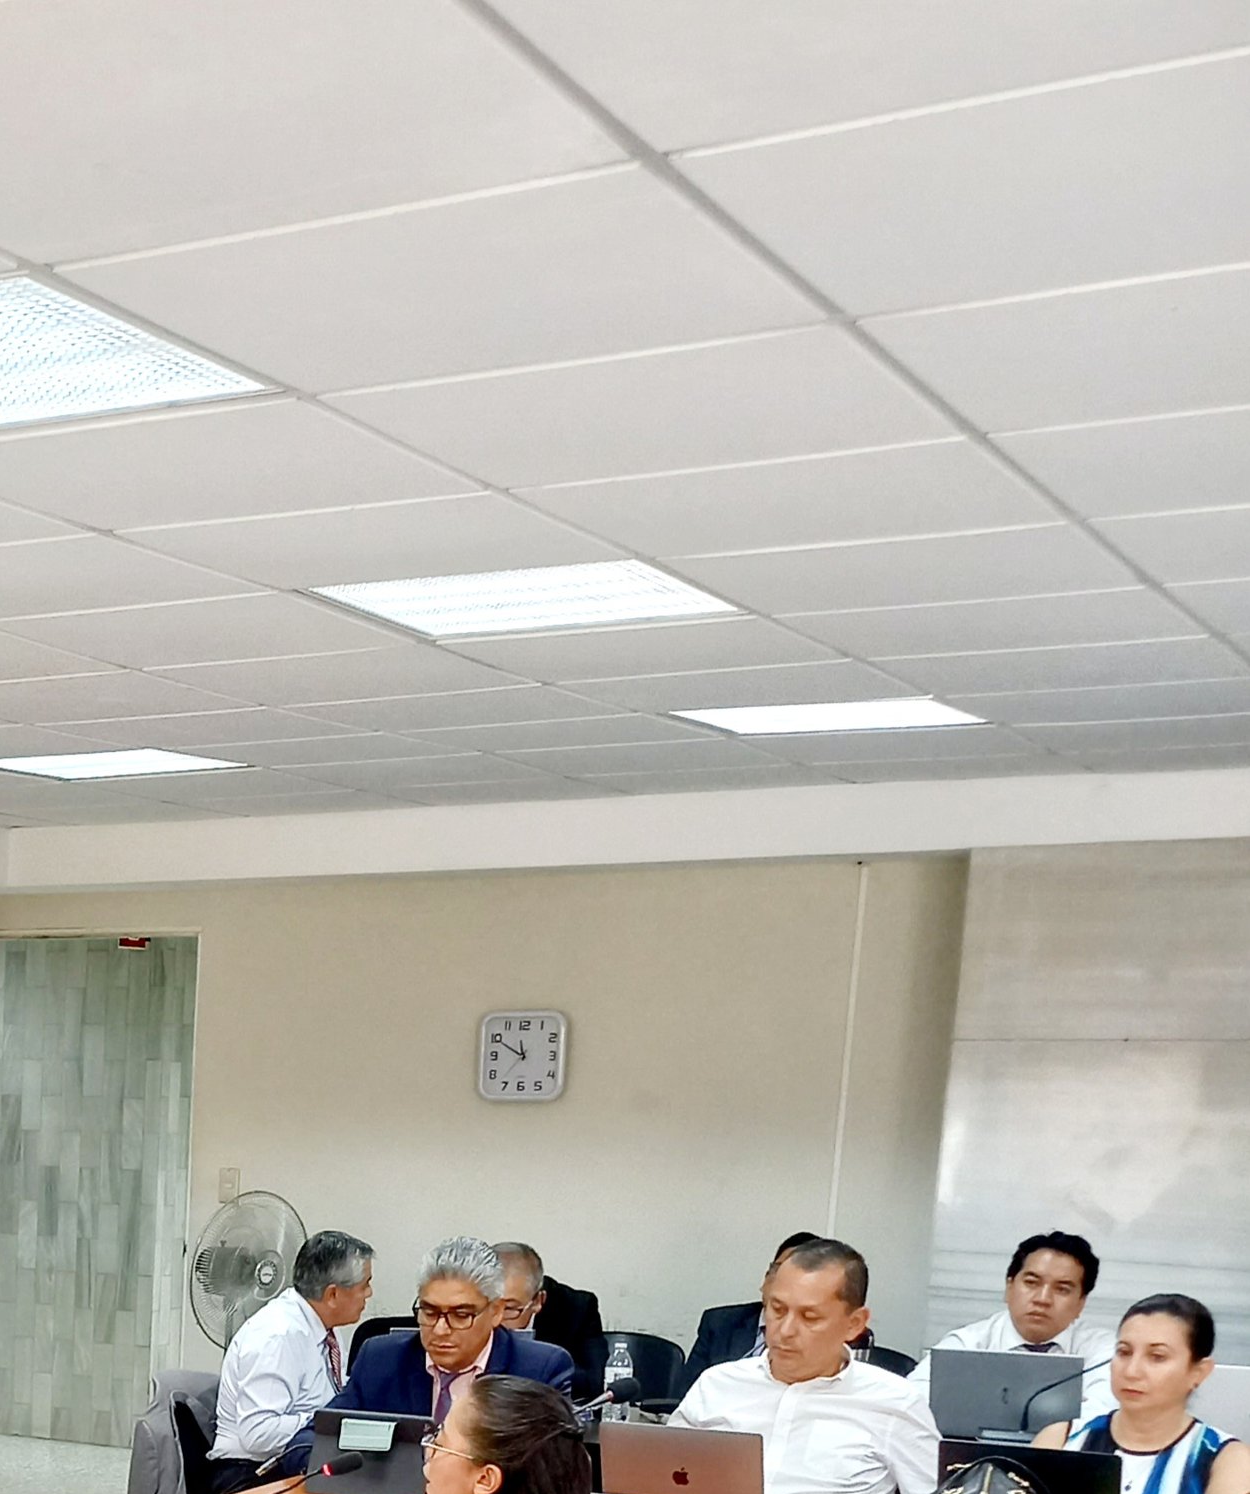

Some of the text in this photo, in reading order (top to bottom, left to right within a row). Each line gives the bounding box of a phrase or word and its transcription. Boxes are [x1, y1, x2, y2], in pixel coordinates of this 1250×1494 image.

[505, 1020, 511, 1031] 11
[519, 1020, 531, 1031] 12
[540, 1020, 544, 1031] 1
[491, 1033, 502, 1043] 10
[548, 1032, 558, 1043] 2
[490, 1051, 498, 1061] 9
[548, 1051, 556, 1061] 3
[489, 1069, 497, 1080] 8
[546, 1070, 555, 1079] 4
[501, 1081, 509, 1091] 7
[516, 1081, 525, 1091] 6
[534, 1081, 542, 1091] 5
